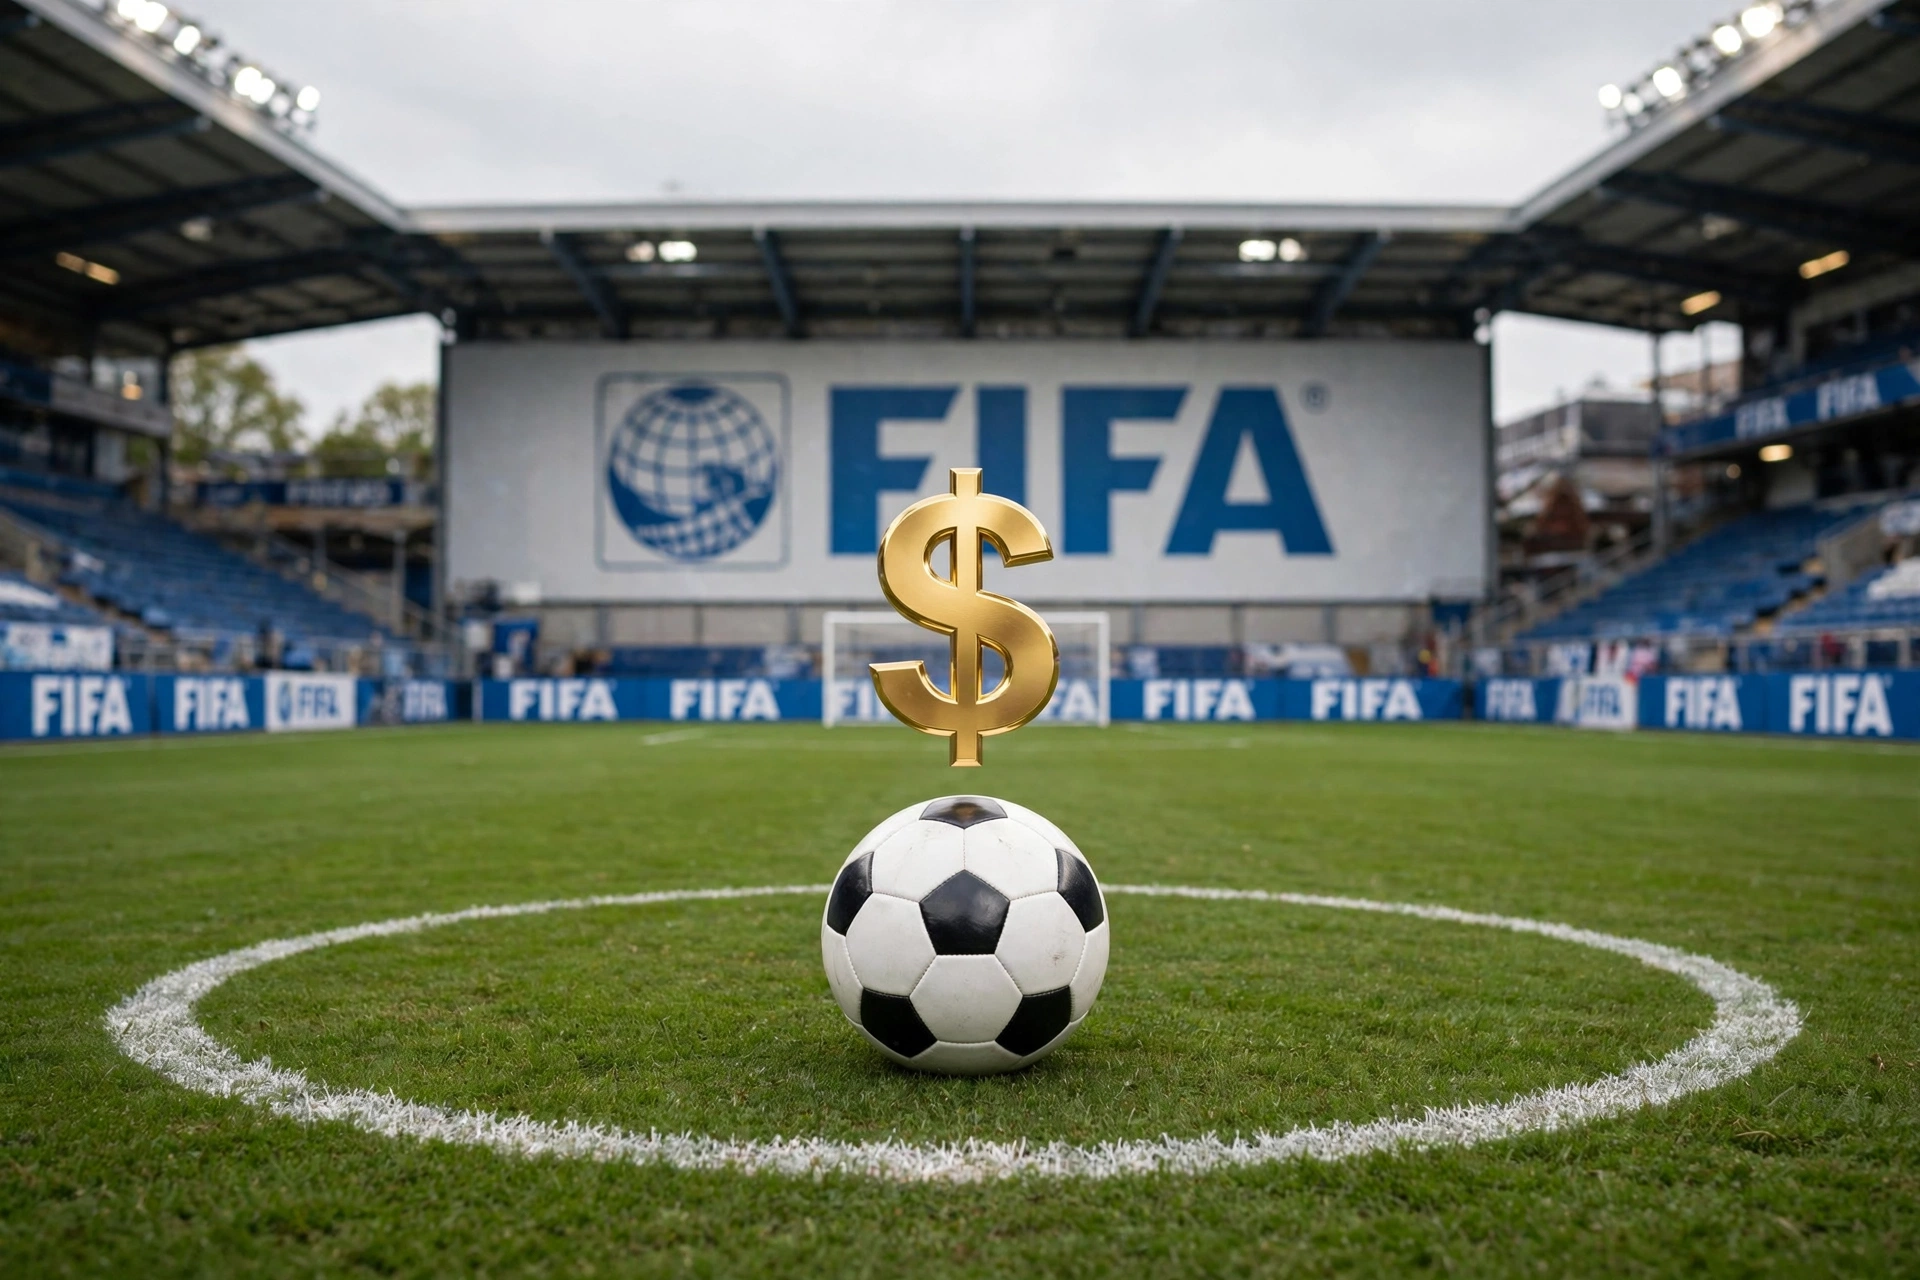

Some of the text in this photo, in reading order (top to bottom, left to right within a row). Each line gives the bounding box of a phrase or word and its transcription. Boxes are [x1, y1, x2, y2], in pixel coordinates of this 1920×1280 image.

[32, 675, 132, 735] FIFA
[174, 677, 249, 730] FIFA
[510, 678, 617, 721] FIFA
[670, 679, 780, 721] FIFA
[1143, 678, 1254, 721] FIFA
[1311, 677, 1422, 721] FIFA
[1665, 677, 1742, 730] FIFA
[1789, 674, 1893, 735] FIFA
